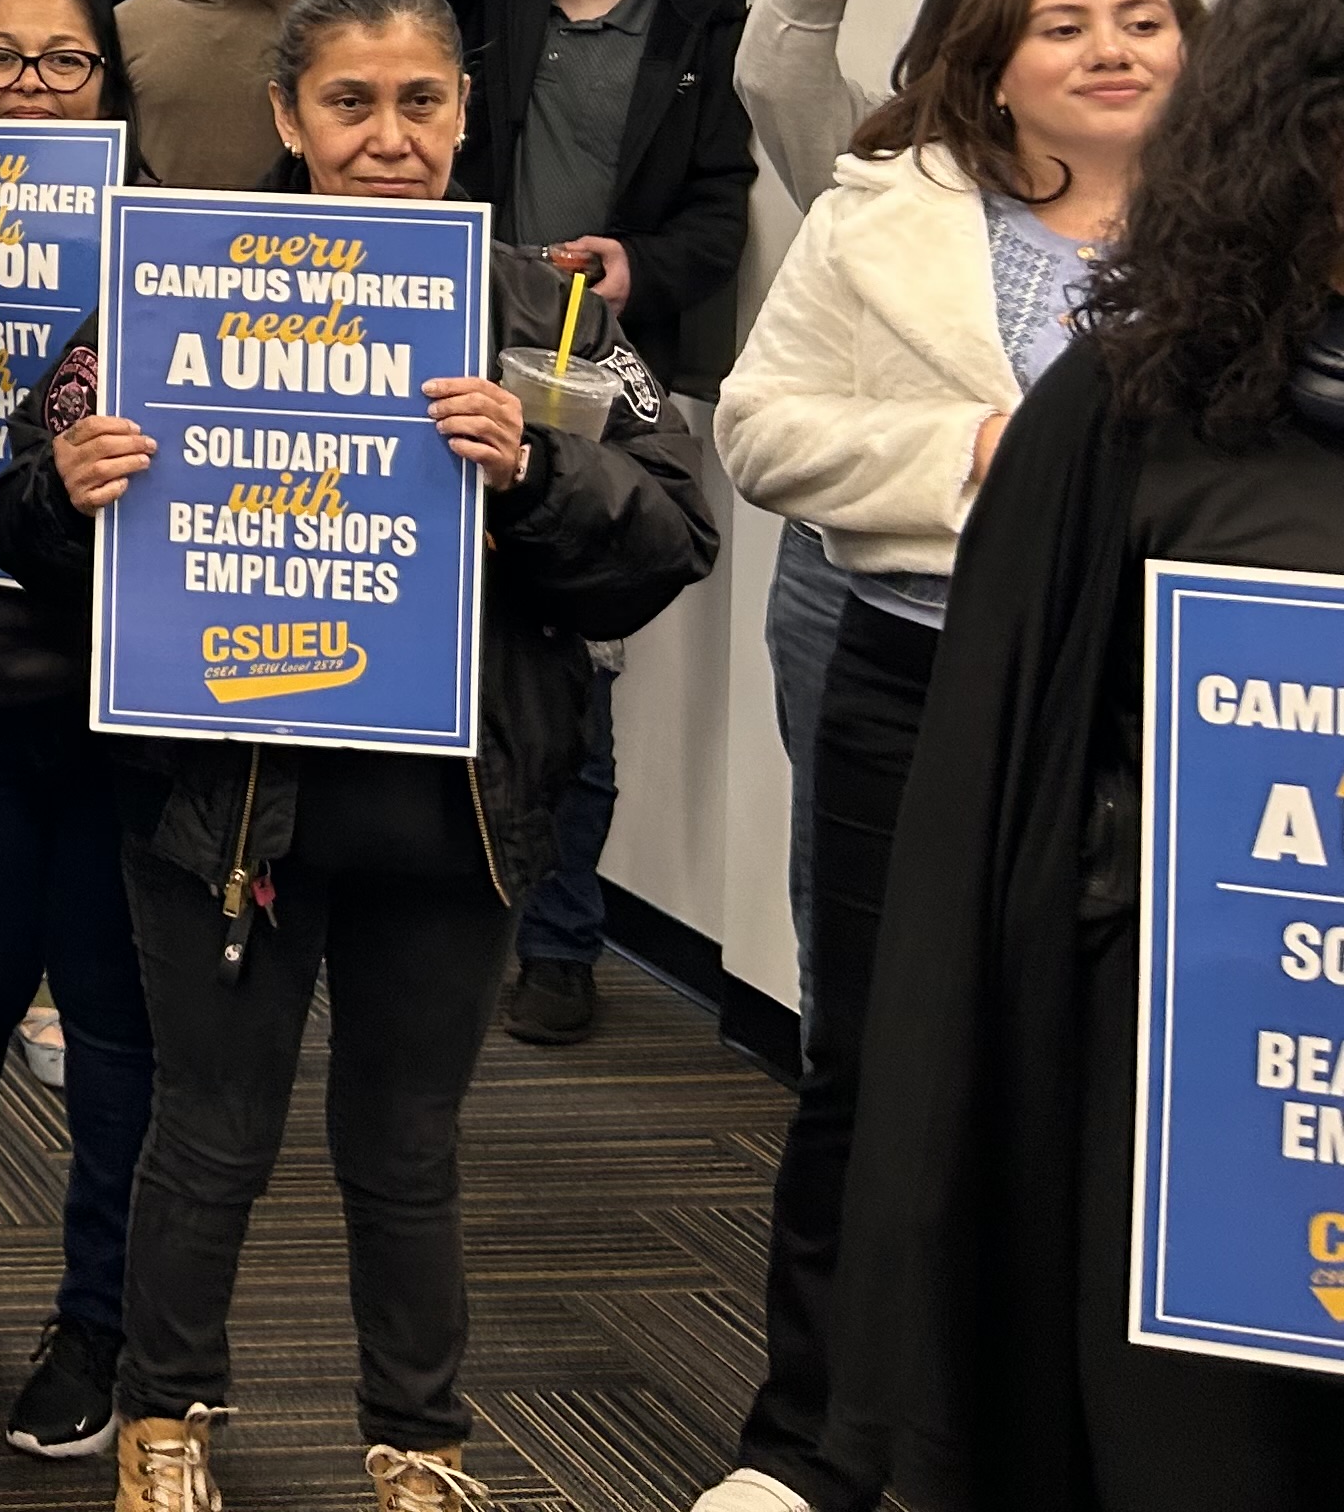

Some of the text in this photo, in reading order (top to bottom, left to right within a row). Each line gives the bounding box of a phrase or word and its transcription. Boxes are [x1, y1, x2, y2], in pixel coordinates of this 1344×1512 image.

[229, 232, 367, 273] every
[134, 262, 455, 311] CAMPUS WORKER
[217, 300, 368, 345] needs
[166, 333, 211, 388] A
[221, 335, 411, 398] UNION
[183, 425, 399, 476] SOLIDARITY
[228, 467, 348, 519] with
[169, 503, 417, 557] BEACH SHOPS
[184, 551, 399, 604] EMPLOYEES
[202, 621, 348, 663] CSUEU
[204, 659, 344, 678] CSEA SEIU Local 2579
[1252, 783, 1328, 866] A
